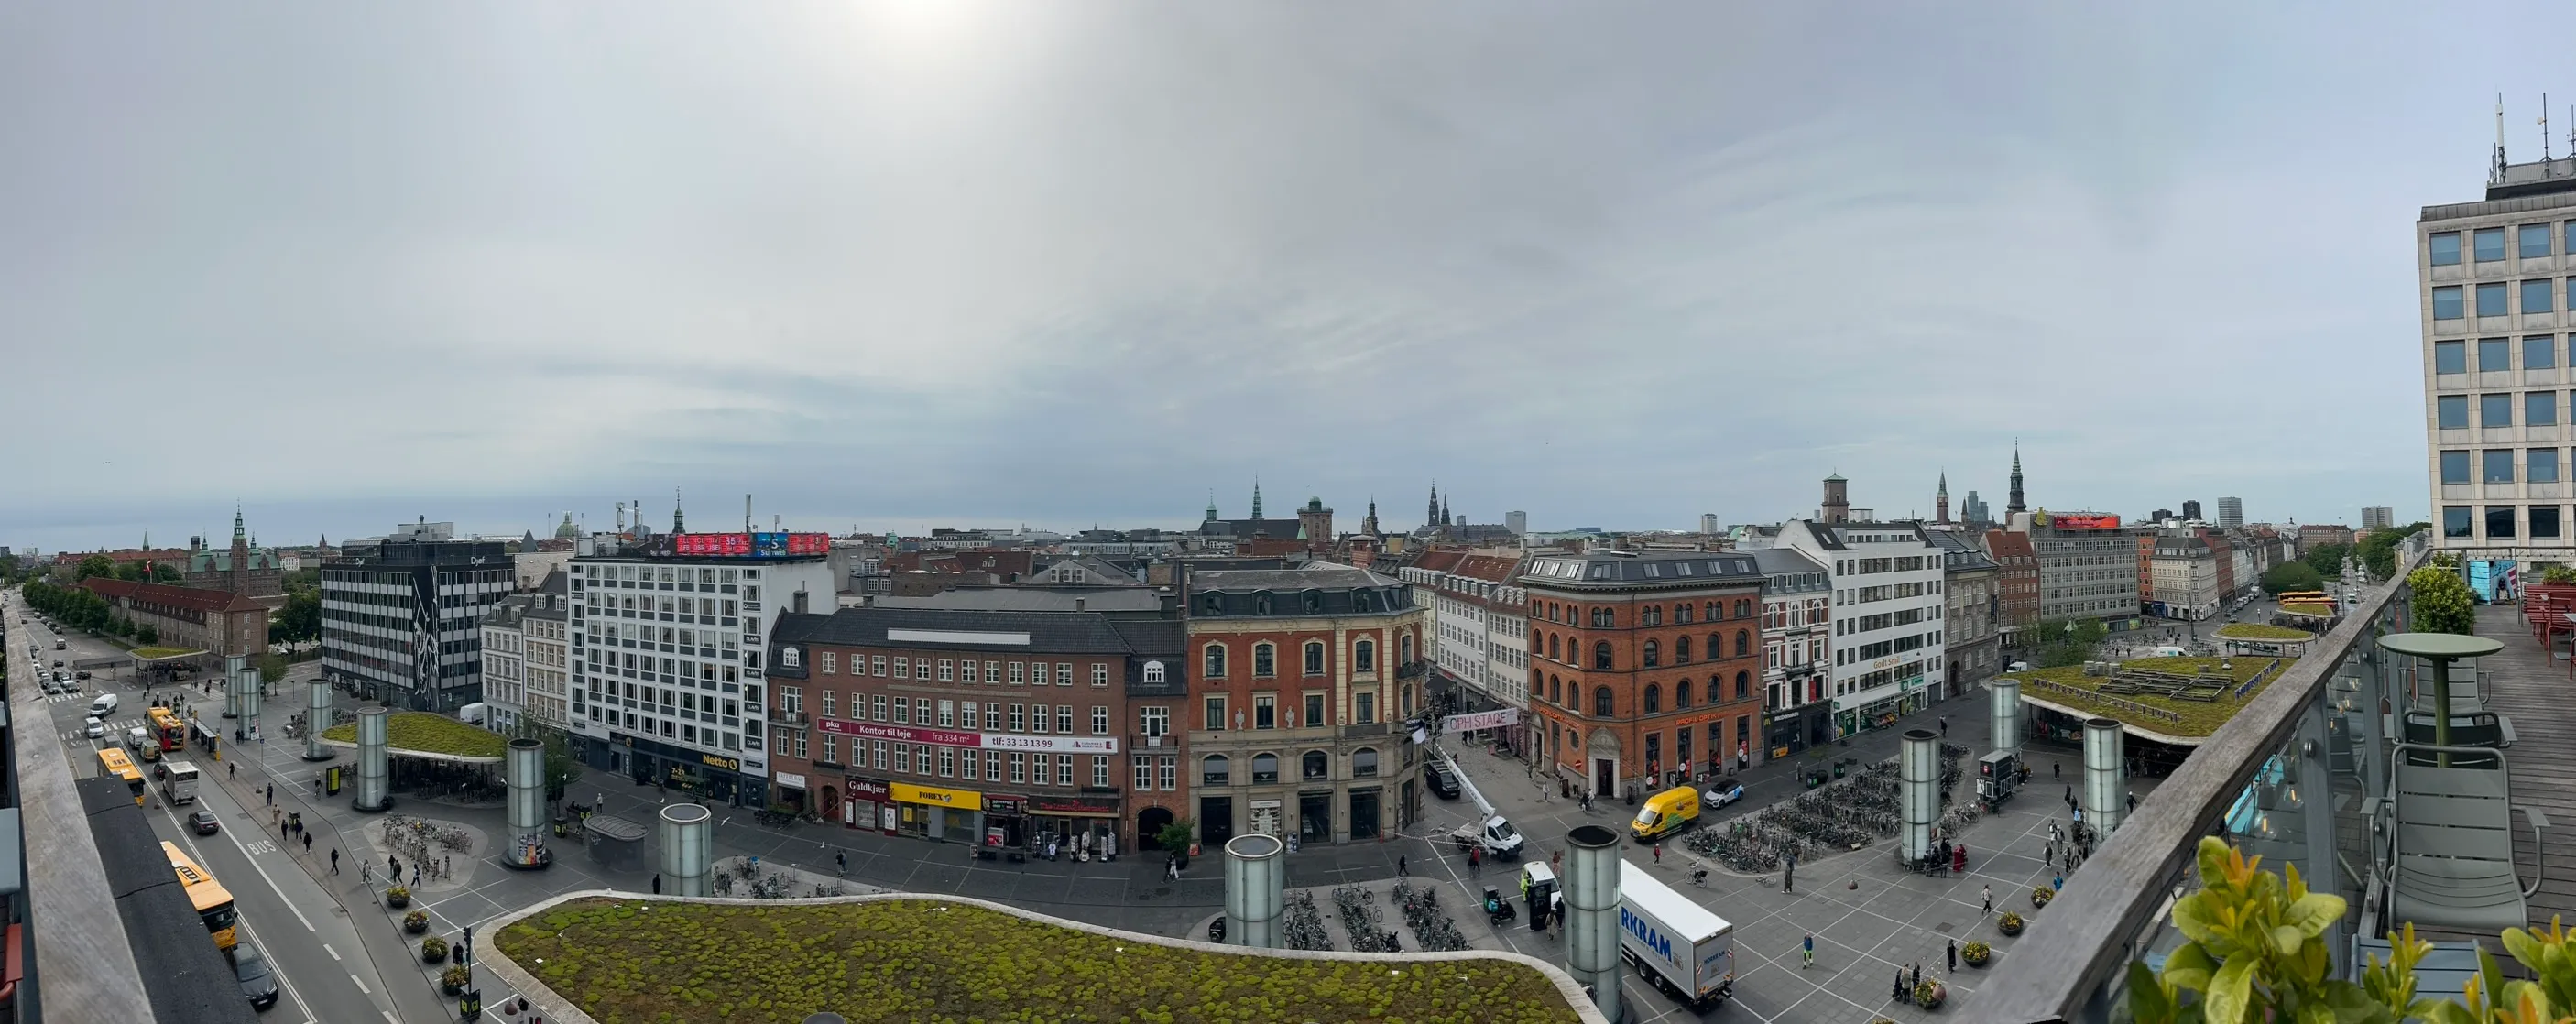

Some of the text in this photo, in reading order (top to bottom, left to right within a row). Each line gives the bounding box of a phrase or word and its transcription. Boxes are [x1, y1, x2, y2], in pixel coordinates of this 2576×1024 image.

[1874, 659, 1887, 669] Godt
[1450, 712, 1506, 731] CPH STAGE
[860, 725, 886, 737] Kontor
[887, 728, 895, 737] til
[897, 729, 911, 740] leje
[932, 732, 942, 741] fra
[944, 734, 958, 742] 334
[703, 754, 728, 768] Netto
[849, 781, 886, 794] Guldkjær
[919, 792, 943, 801] FOREX
[247, 840, 276, 855] BUS
[1621, 906, 1672, 963] RKRAM
